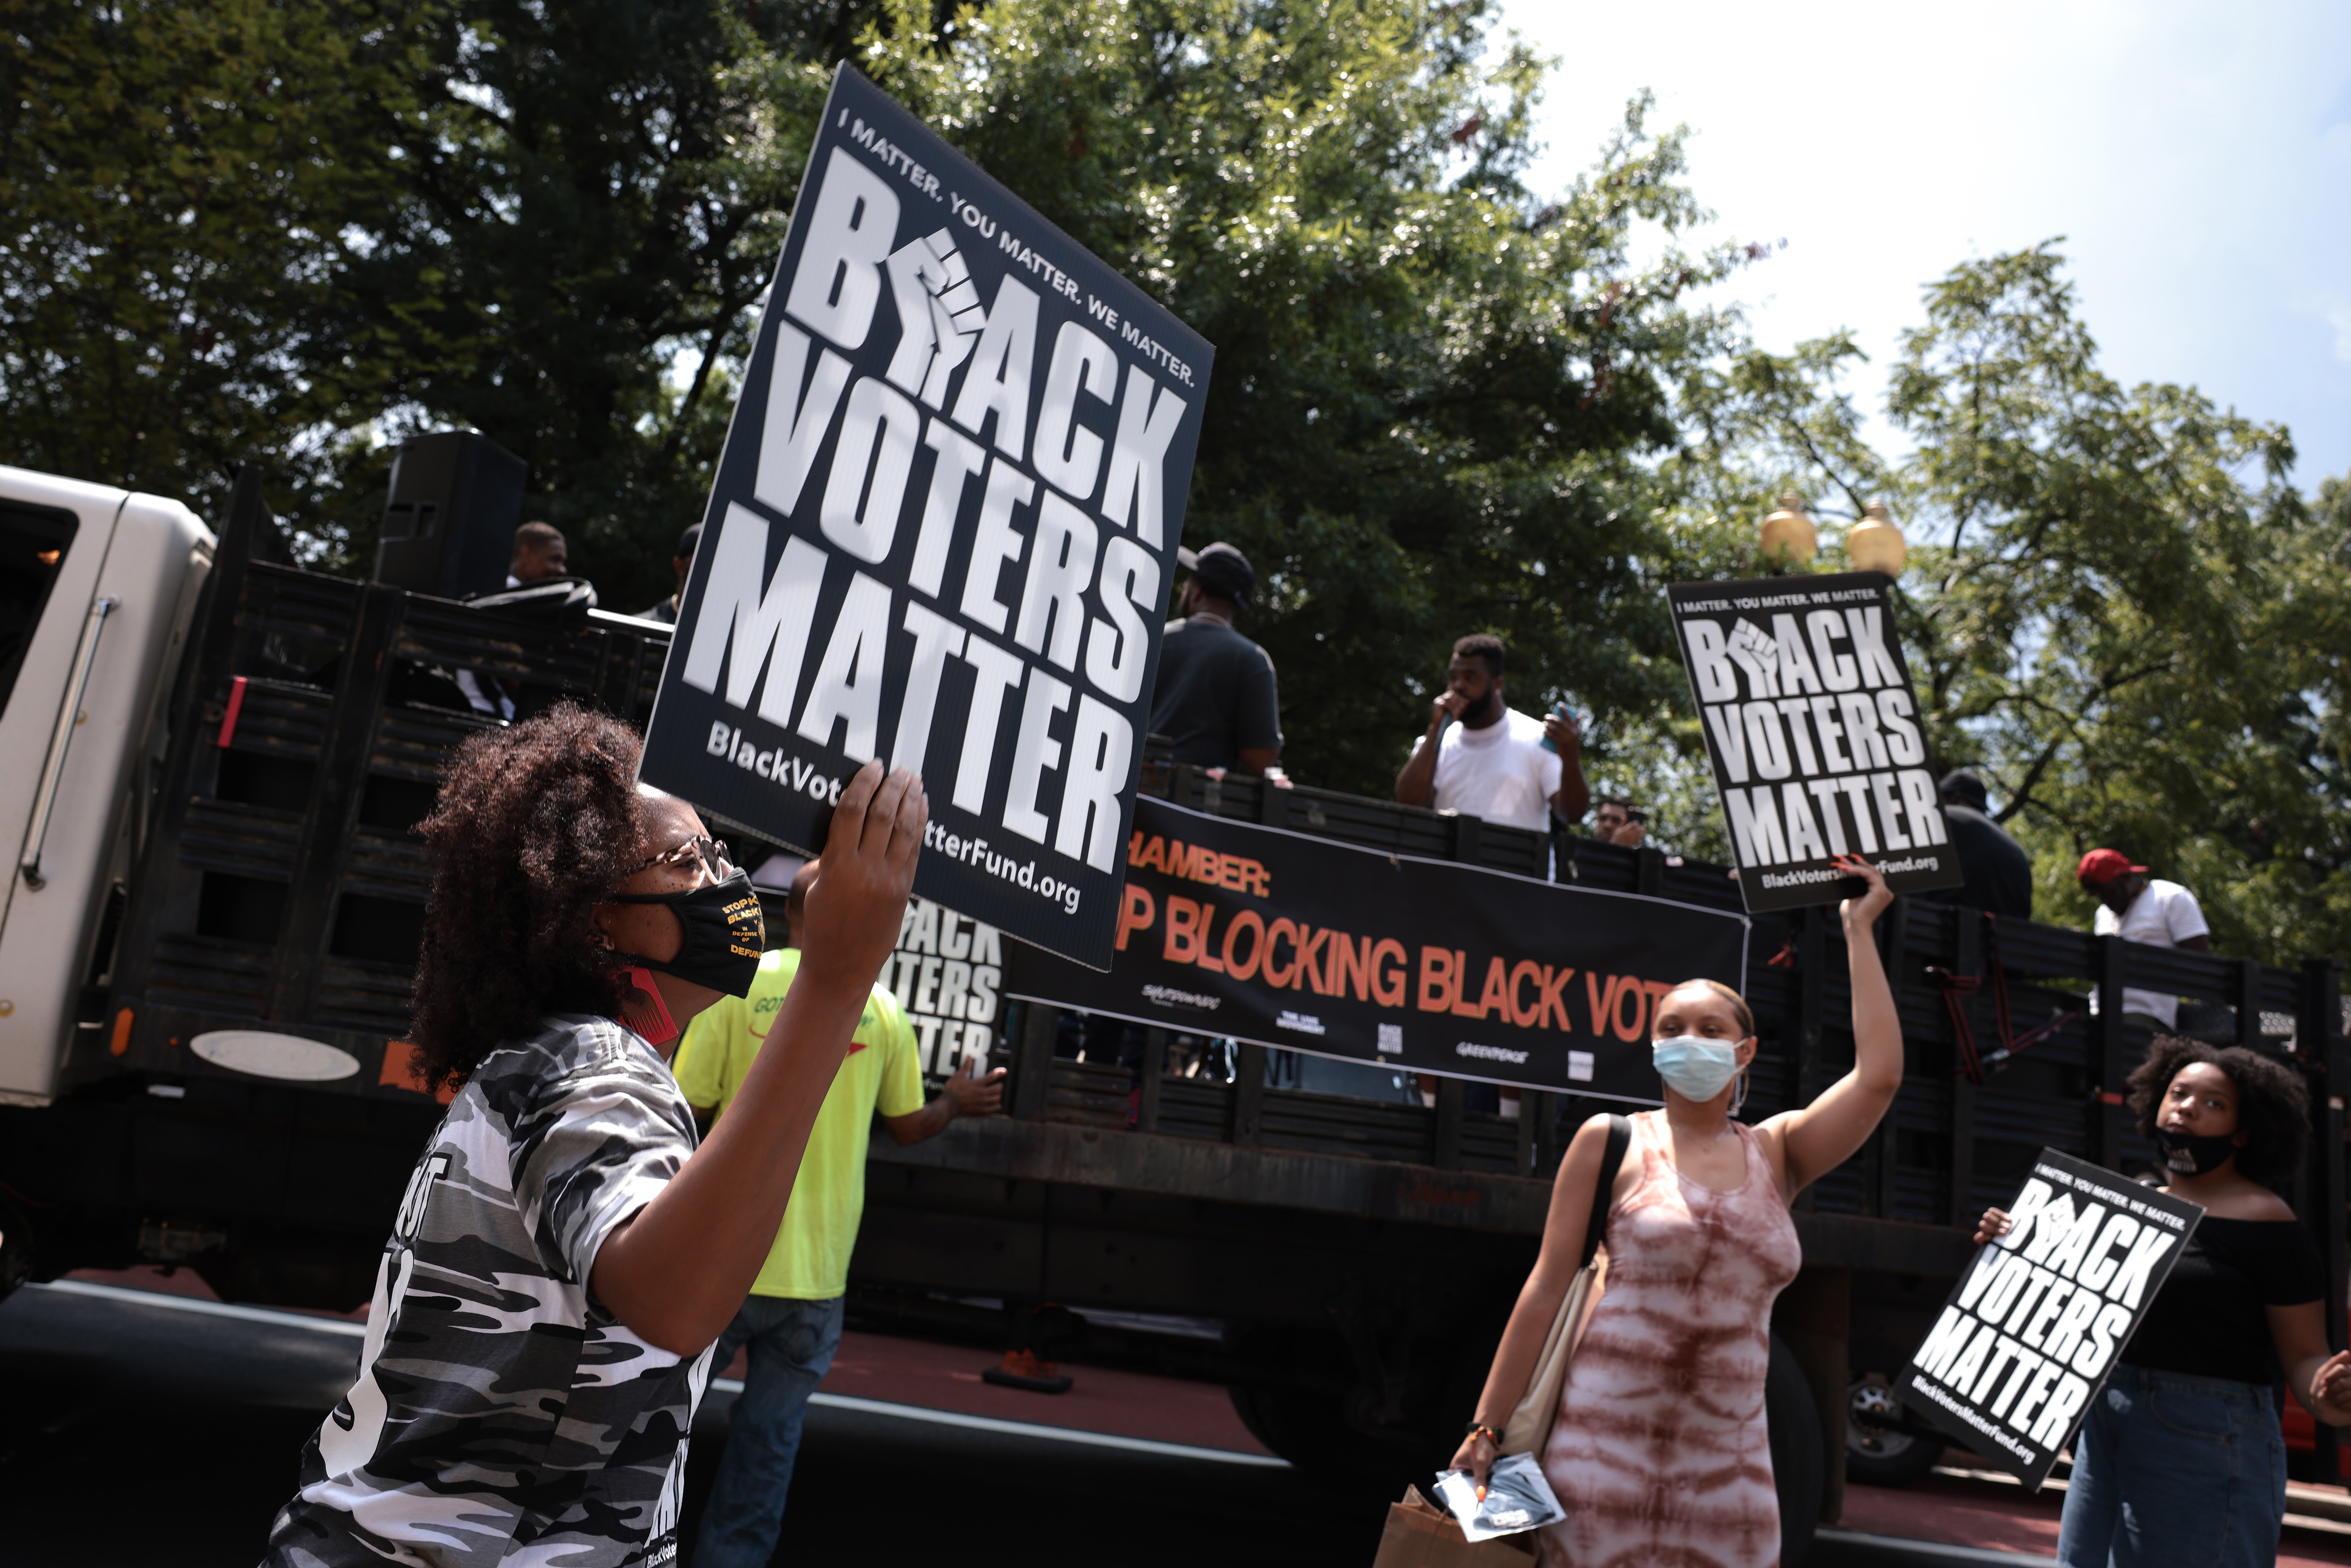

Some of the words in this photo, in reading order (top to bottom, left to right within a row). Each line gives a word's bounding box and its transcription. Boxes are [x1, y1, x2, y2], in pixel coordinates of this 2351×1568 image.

[837, 107, 849, 128] I
[850, 118, 943, 203] MATTER.
[950, 191, 997, 239] YOU
[999, 230, 1082, 305] MATTER.
[1088, 294, 1119, 331] WE
[1121, 320, 1195, 387] MATTER.
[785, 145, 1187, 551] BACK
[754, 319, 1161, 703] VOTERS
[1677, 602, 1681, 613] I
[1683, 599, 1733, 612] MATTER.
[1733, 597, 1759, 610] YOU
[1761, 593, 1810, 608] MATTER.
[1810, 592, 1831, 604] WE
[1832, 588, 1880, 602] MATTER.
[682, 500, 1133, 875] MATTER
[1682, 606, 1903, 703] BACK
[1704, 689, 1925, 783] VOTERS
[706, 721, 1081, 915] BlackVottterFund.org
[1128, 831, 1271, 898] HAMBER:
[1725, 769, 1948, 868] MATTER
[722, 898, 748, 914] STOP
[728, 907, 760, 925] BLACK
[1761, 857, 1938, 888] BlackVotersrFund.org
[731, 944, 761, 959] DEFUN
[897, 899, 1001, 966] ACK
[1163, 895, 1407, 1007] BLOCKING
[1418, 946, 1576, 1032] BLACK
[1586, 971, 1675, 1043] VOT
[878, 952, 1001, 1023] TERS
[1994, 1177, 2176, 1310] BACK
[2034, 1163, 2042, 1173] I
[2039, 1164, 2073, 1186] MATTER.
[2073, 1177, 2094, 1193] YOU
[2092, 1185, 2129, 1208] MATTER.
[2129, 1199, 2148, 1215] WE
[2144, 1206, 2186, 1231] MATTER.
[1957, 1244, 2132, 1379] VOTERS
[1912, 1305, 2090, 1452] MATTER
[1912, 1375, 2036, 1465] BlackVotersMatterFund.org
